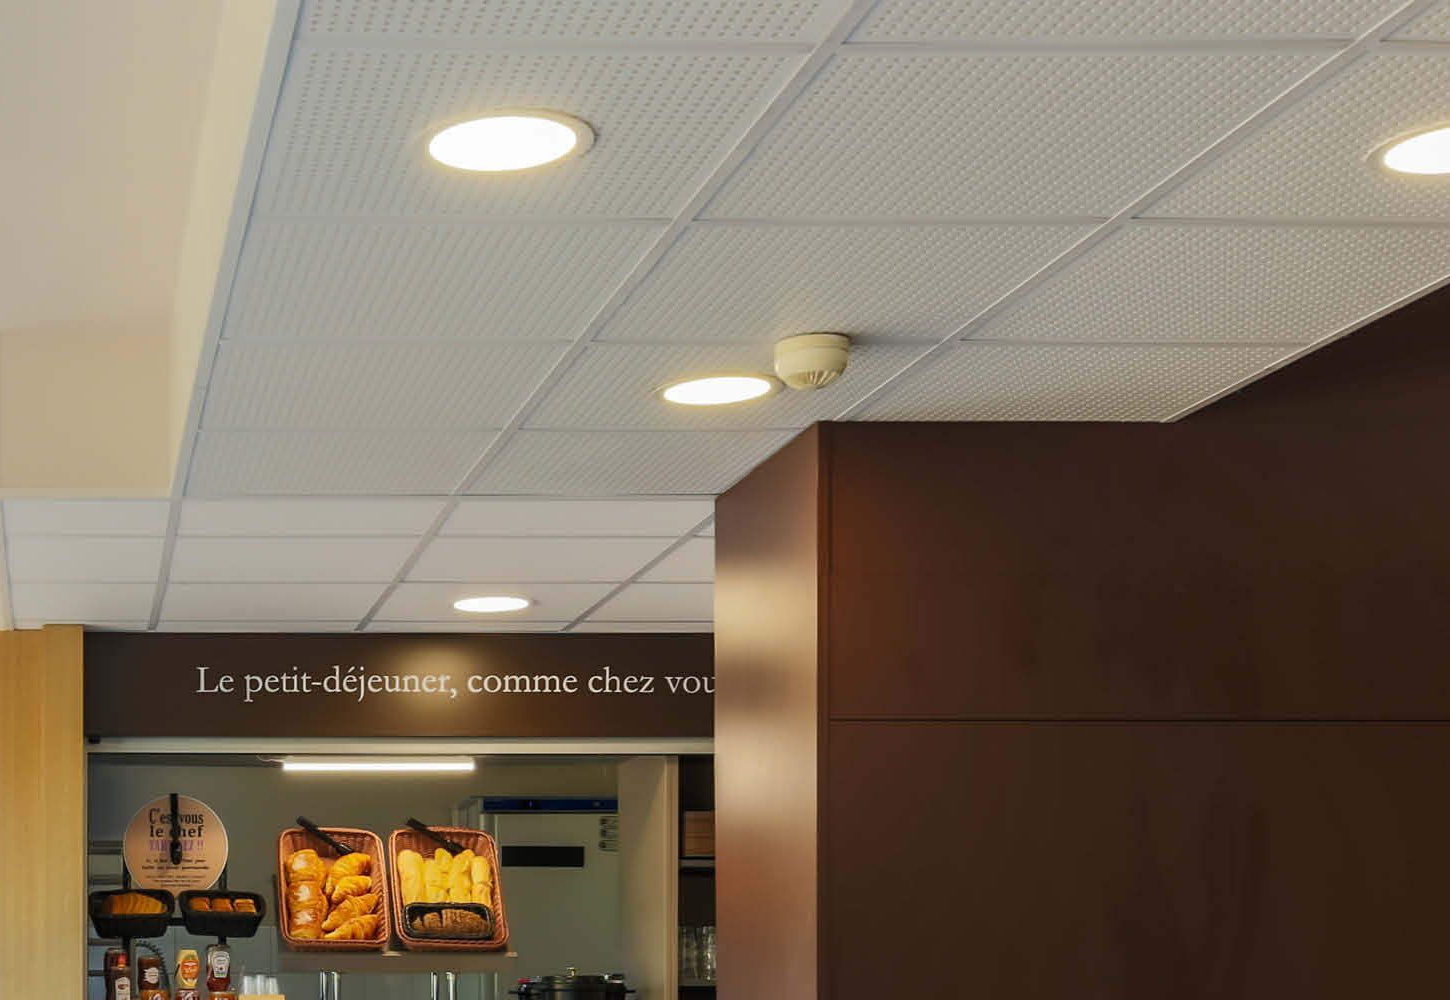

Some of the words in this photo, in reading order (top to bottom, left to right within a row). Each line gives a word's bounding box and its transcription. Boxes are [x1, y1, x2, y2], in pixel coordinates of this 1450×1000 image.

[195, 665, 235, 693] Le
[243, 665, 458, 703] petit-déjeuner,
[467, 674, 579, 693] comme
[587, 666, 655, 693] chez
[149, 807, 174, 825] C'es
[150, 825, 164, 838] le
